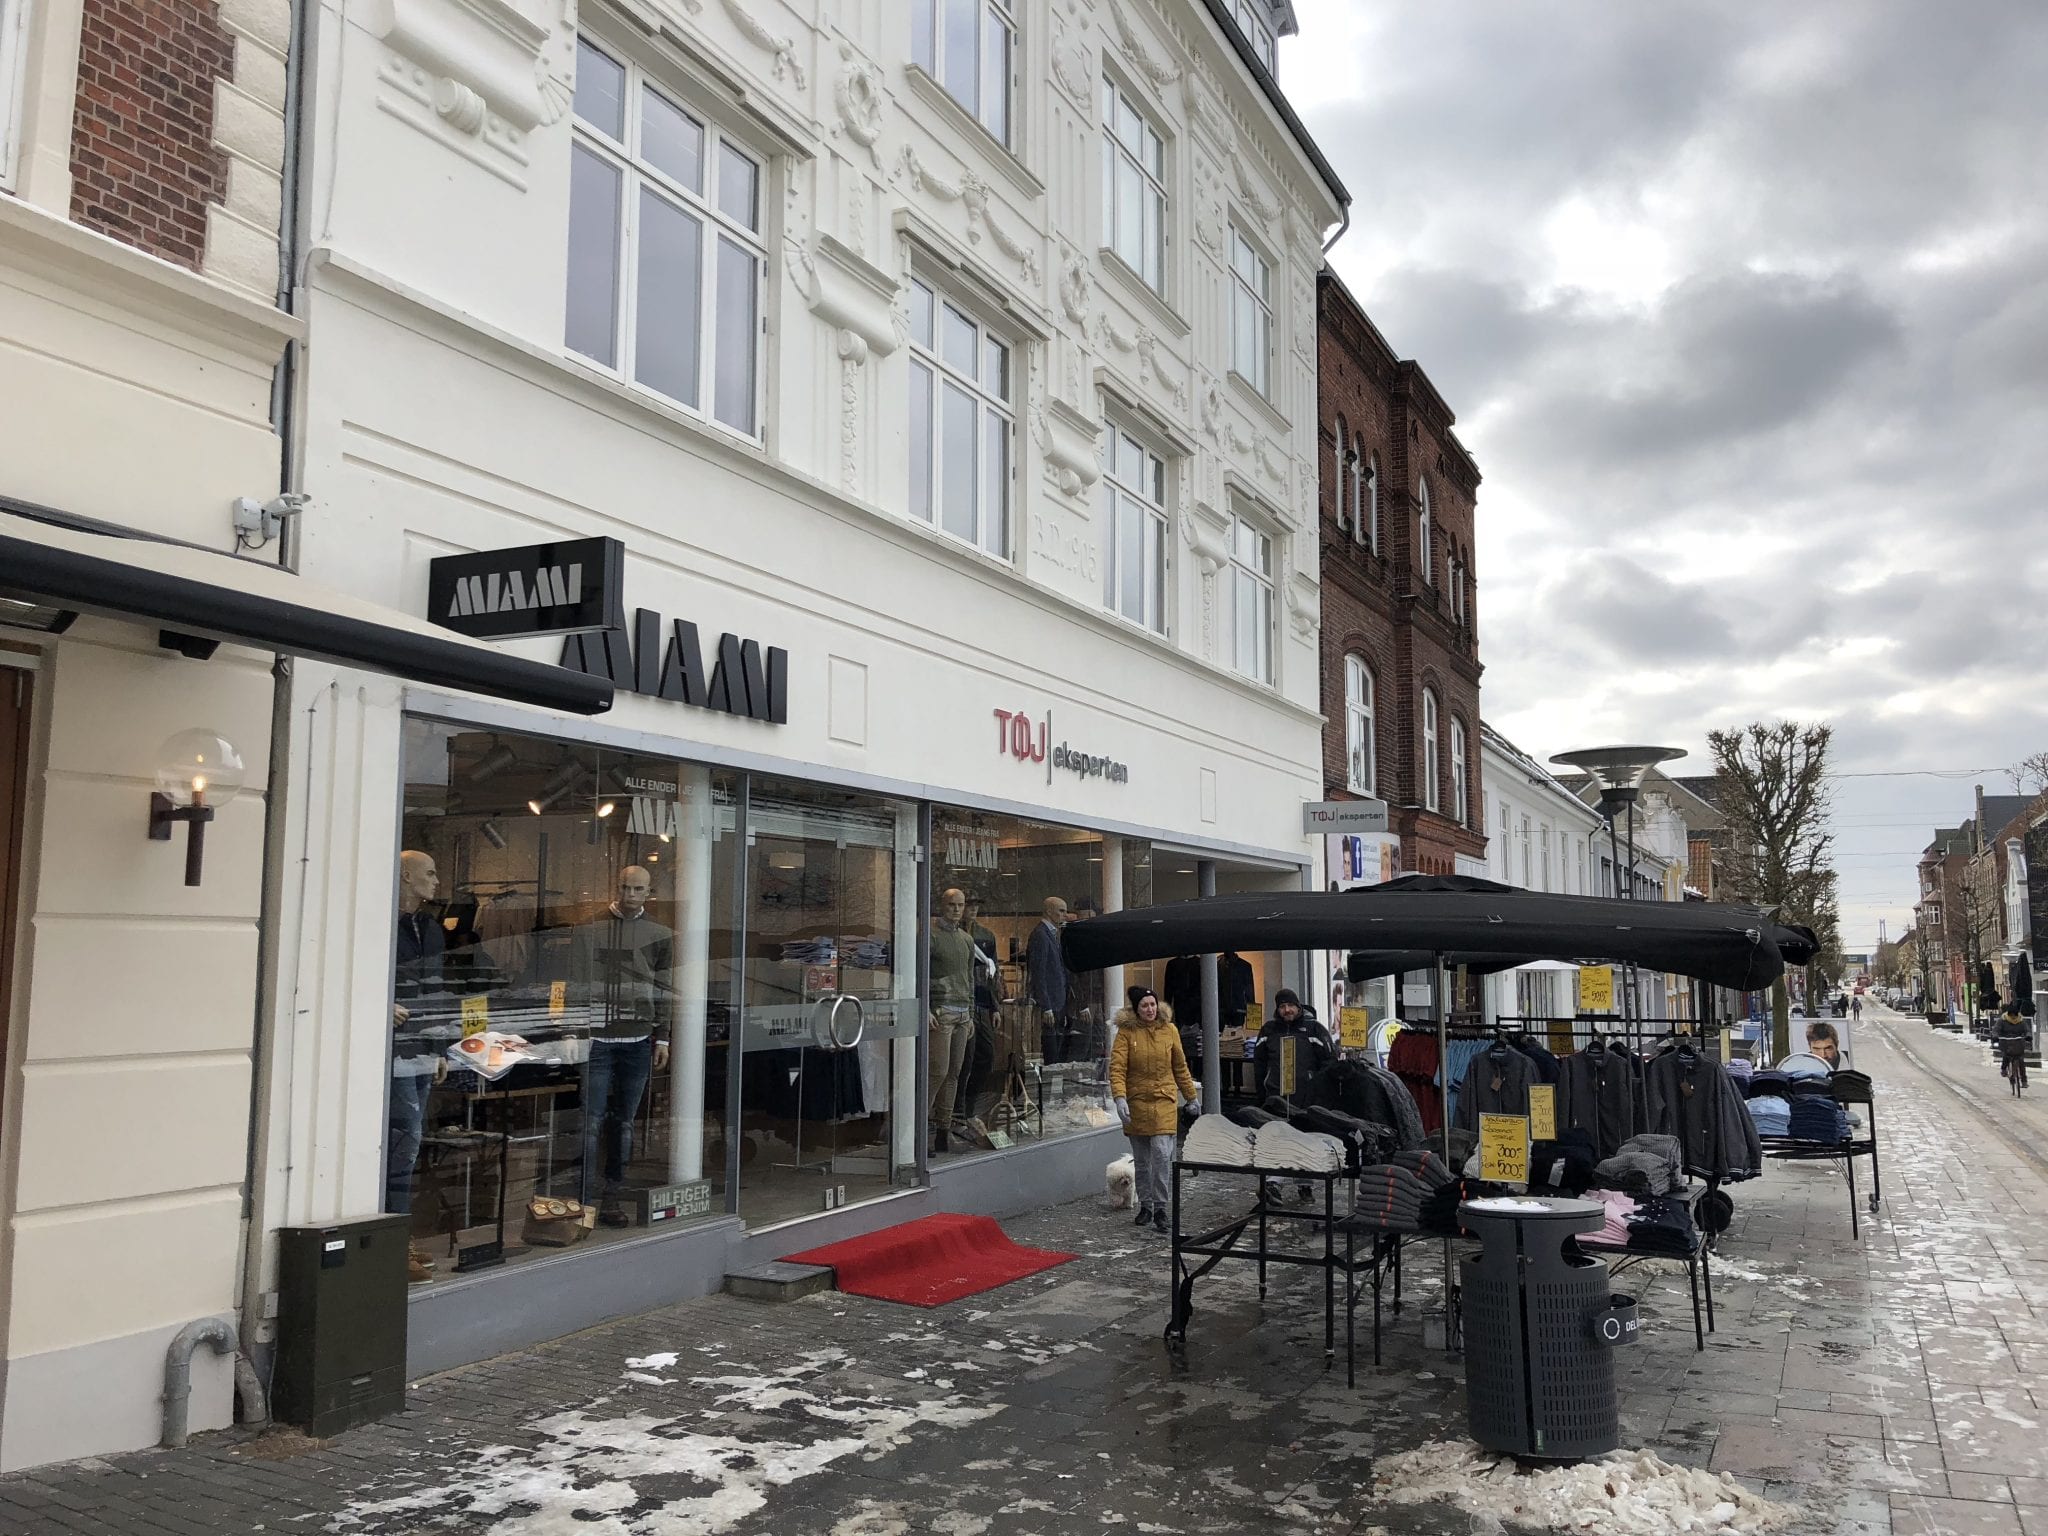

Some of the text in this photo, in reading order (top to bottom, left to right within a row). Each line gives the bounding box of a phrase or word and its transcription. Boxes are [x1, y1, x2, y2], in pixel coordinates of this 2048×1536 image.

[448, 563, 582, 617] MIAMI
[993, 708, 1128, 785] TØJ eksperten
[625, 776, 646, 790] ALLE
[648, 779, 677, 794] ENDER
[1310, 810, 1384, 822] TØJ eksperten
[946, 837, 998, 869] MIAMI
[652, 1185, 709, 1209] HILFIGER
[675, 1199, 710, 1217] DENIM
